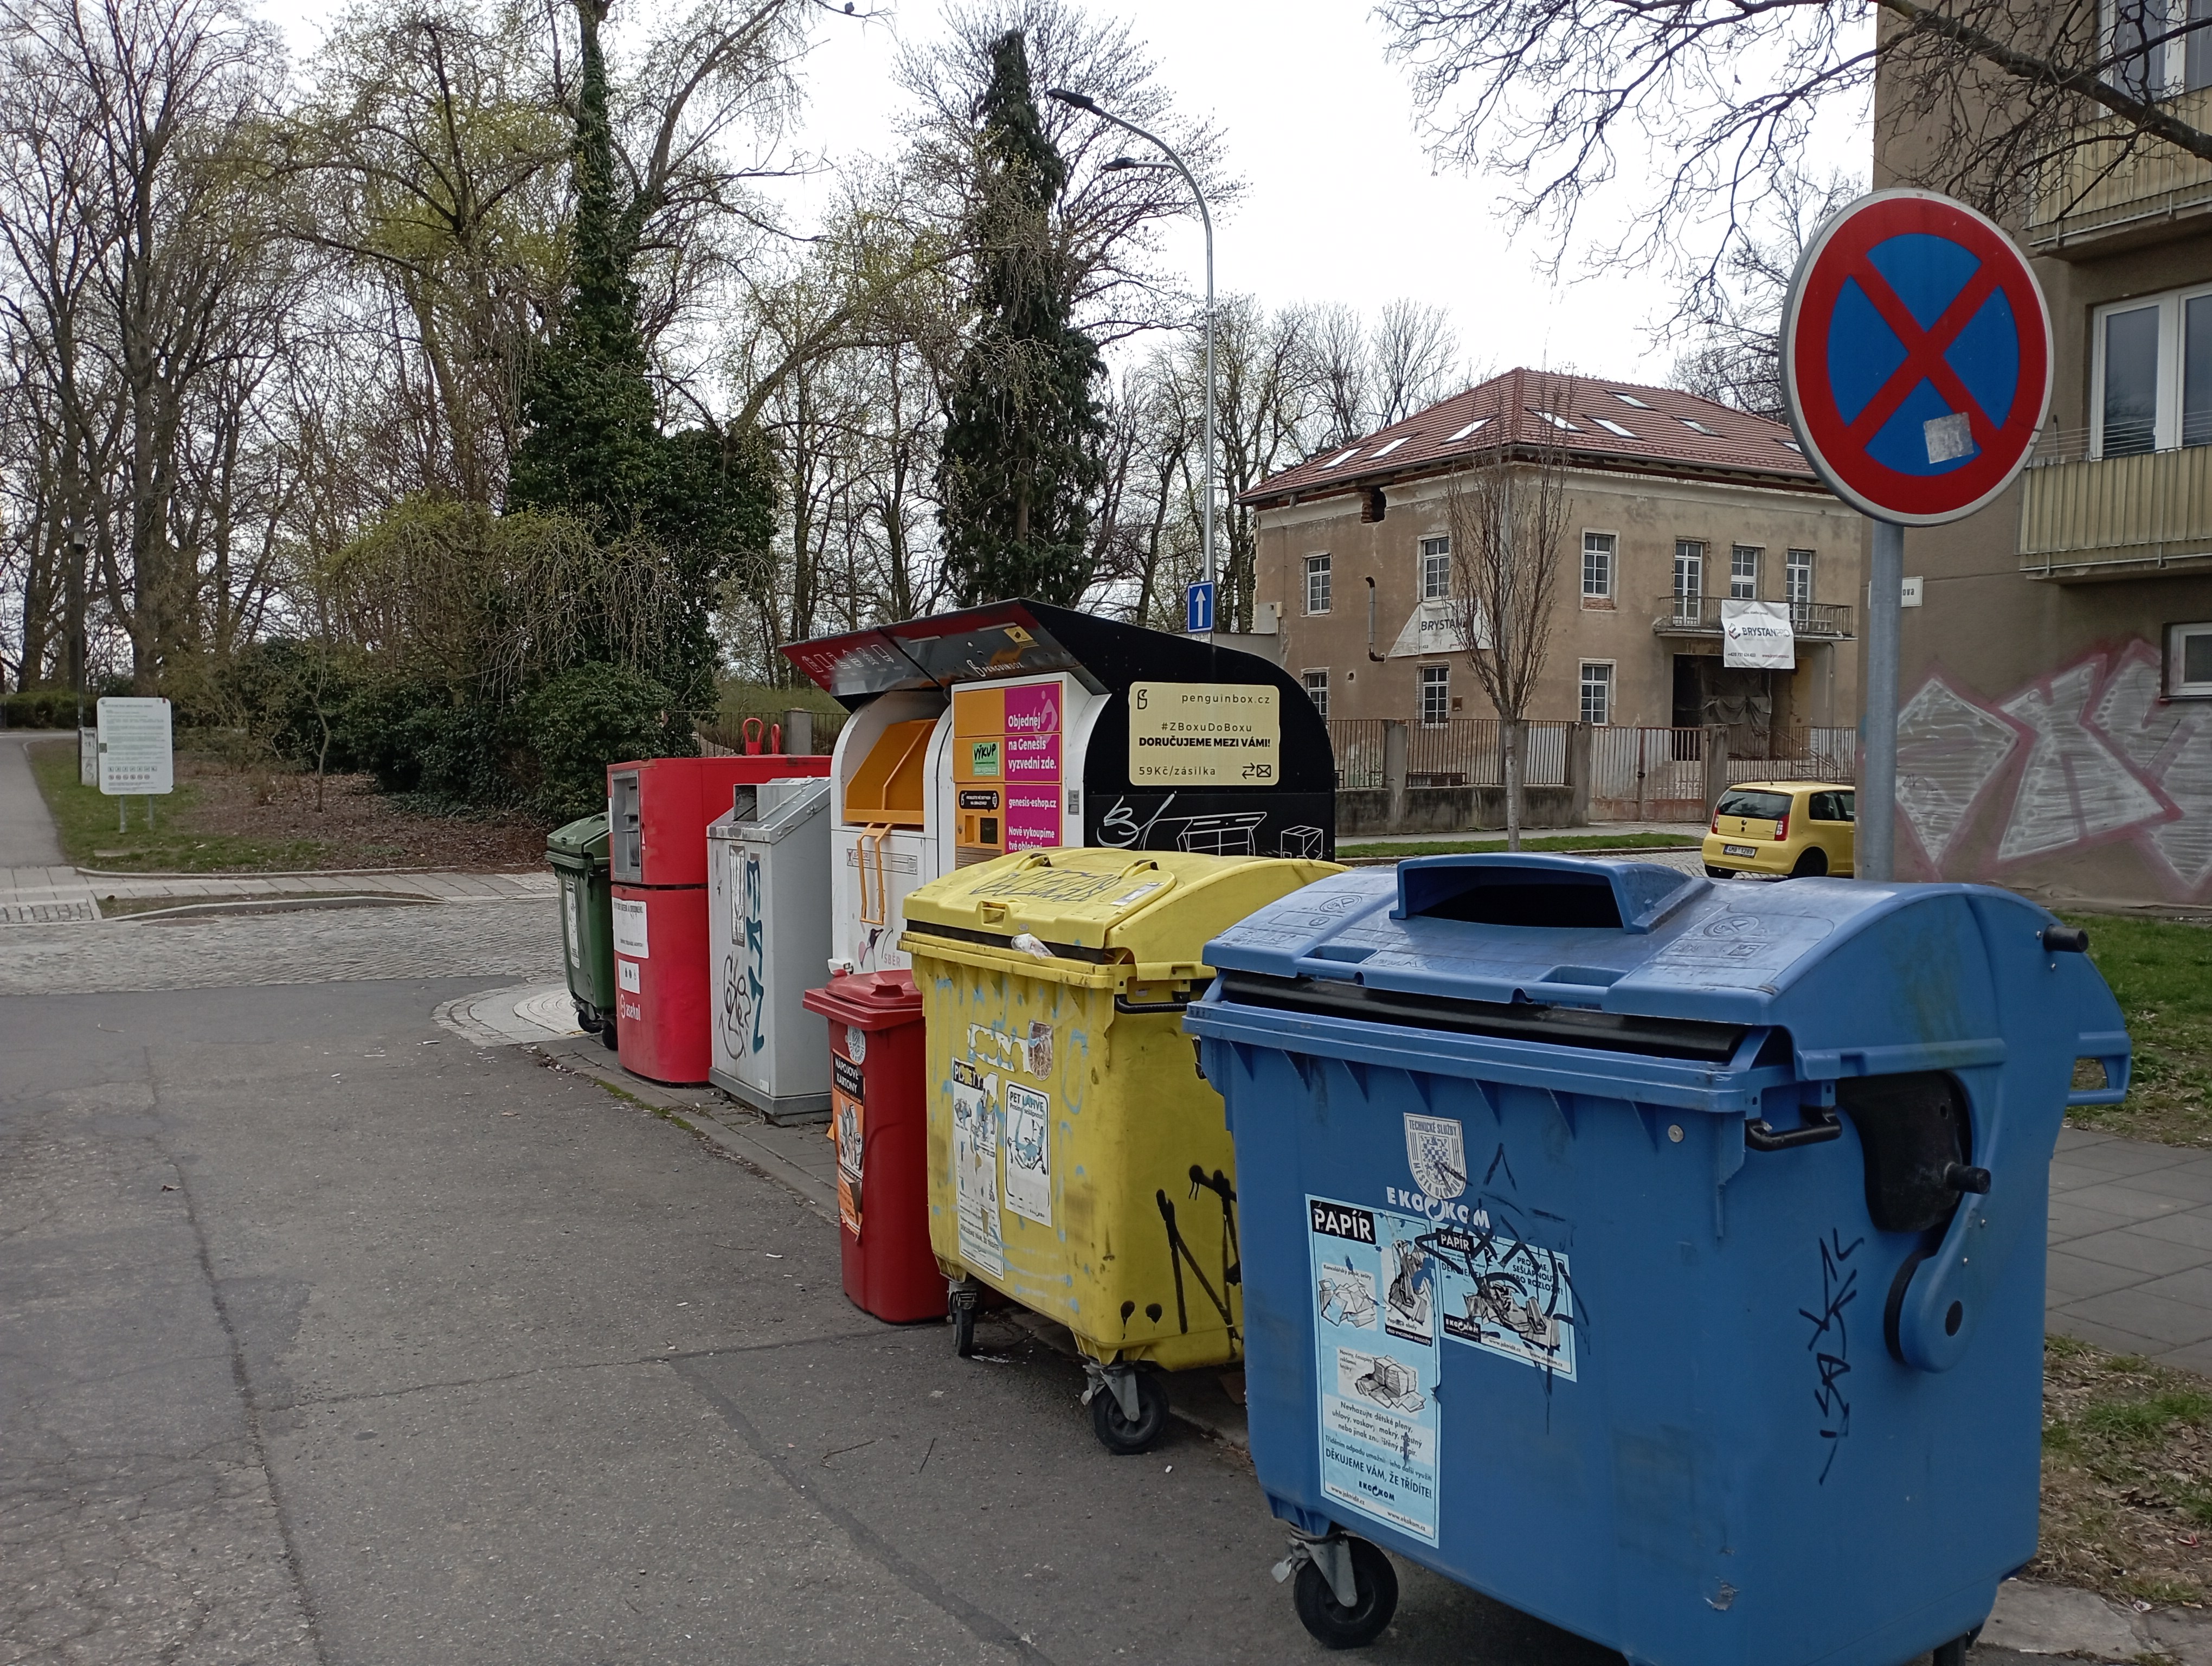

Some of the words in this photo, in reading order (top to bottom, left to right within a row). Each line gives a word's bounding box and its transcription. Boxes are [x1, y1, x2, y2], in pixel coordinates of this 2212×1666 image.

[1182, 694, 1270, 704] penguinbox.cz
[1008, 712, 1041, 729] Objednej
[1161, 722, 1252, 732] #ZBoxuDoBoxu
[1008, 741, 1017, 751] na
[1018, 736, 1046, 751] Genesis
[1139, 735, 1212, 746] DORUČUJEME
[1213, 738, 1239, 747] MEZI
[1240, 736, 1271, 747] VÁMI!
[1008, 755, 1040, 772] vyzvedni
[1041, 756, 1057, 769] zde.
[1139, 766, 1216, 776] 59Kč/zásilka
[1008, 796, 1057, 810] genesis-eshop.cz
[1008, 826, 1022, 836] Nově
[1023, 827, 1055, 840] vykoupíme
[1008, 841, 1017, 850] tvé
[626, 1002, 641, 1021] asekol
[837, 1072, 858, 1094] KARTONY
[1010, 1091, 1021, 1104] PET
[1409, 1119, 1436, 1133] TECHNICKÉ
[1437, 1124, 1457, 1136] SLUŽBY
[1314, 1208, 1372, 1241] PAPÍR
[1441, 1233, 1470, 1251] PAPÍR
[1341, 1401, 1373, 1419] Nevhazujte
[1374, 1412, 1393, 1426] dětské
[1394, 1420, 1413, 1433] pleny,
[1338, 1424, 1352, 1433] nebo
[1353, 1427, 1367, 1438] jinak
[1379, 1427, 1400, 1440] mokrý,
[1346, 1444, 1365, 1456] odpadu
[1326, 1447, 1364, 1472] DĚKUJEME
[1366, 1464, 1387, 1483] VÁM,
[1389, 1471, 1399, 1486] ŽE
[1400, 1476, 1432, 1499] TŘÍDÍTE!
